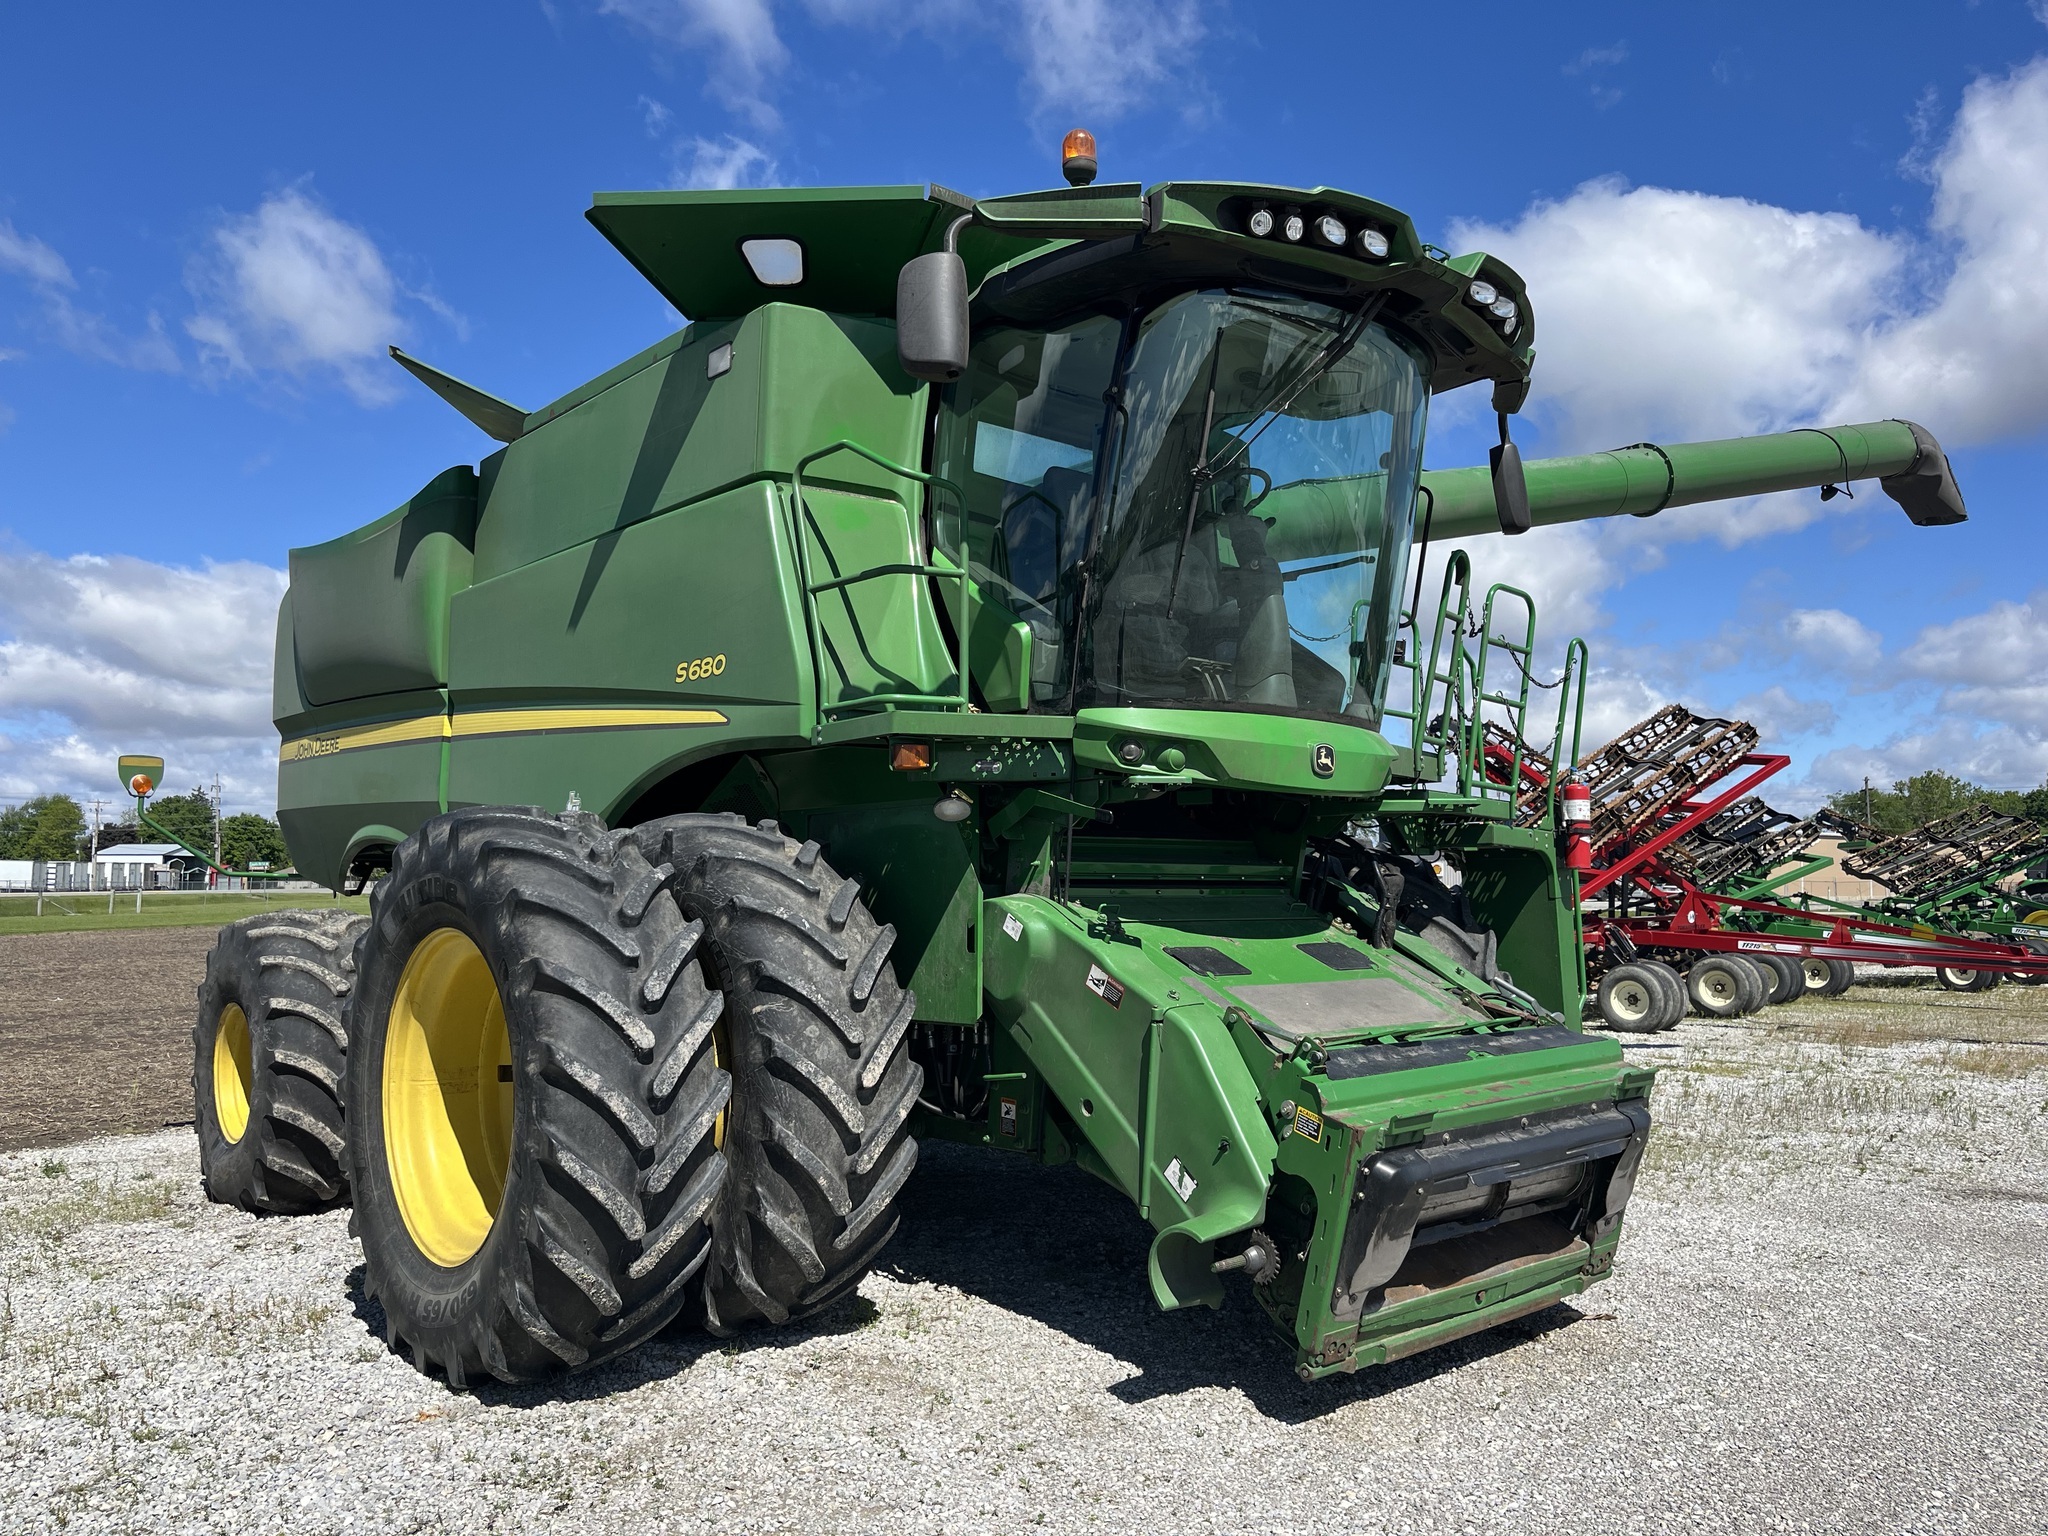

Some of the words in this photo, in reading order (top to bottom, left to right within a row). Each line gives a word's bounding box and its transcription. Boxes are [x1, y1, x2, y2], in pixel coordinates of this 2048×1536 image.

[675, 653, 727, 684] S680
[294, 741, 316, 760] JOHN
[315, 736, 340, 756] DEERE
[1302, 1109, 1323, 1123] CAUTION
